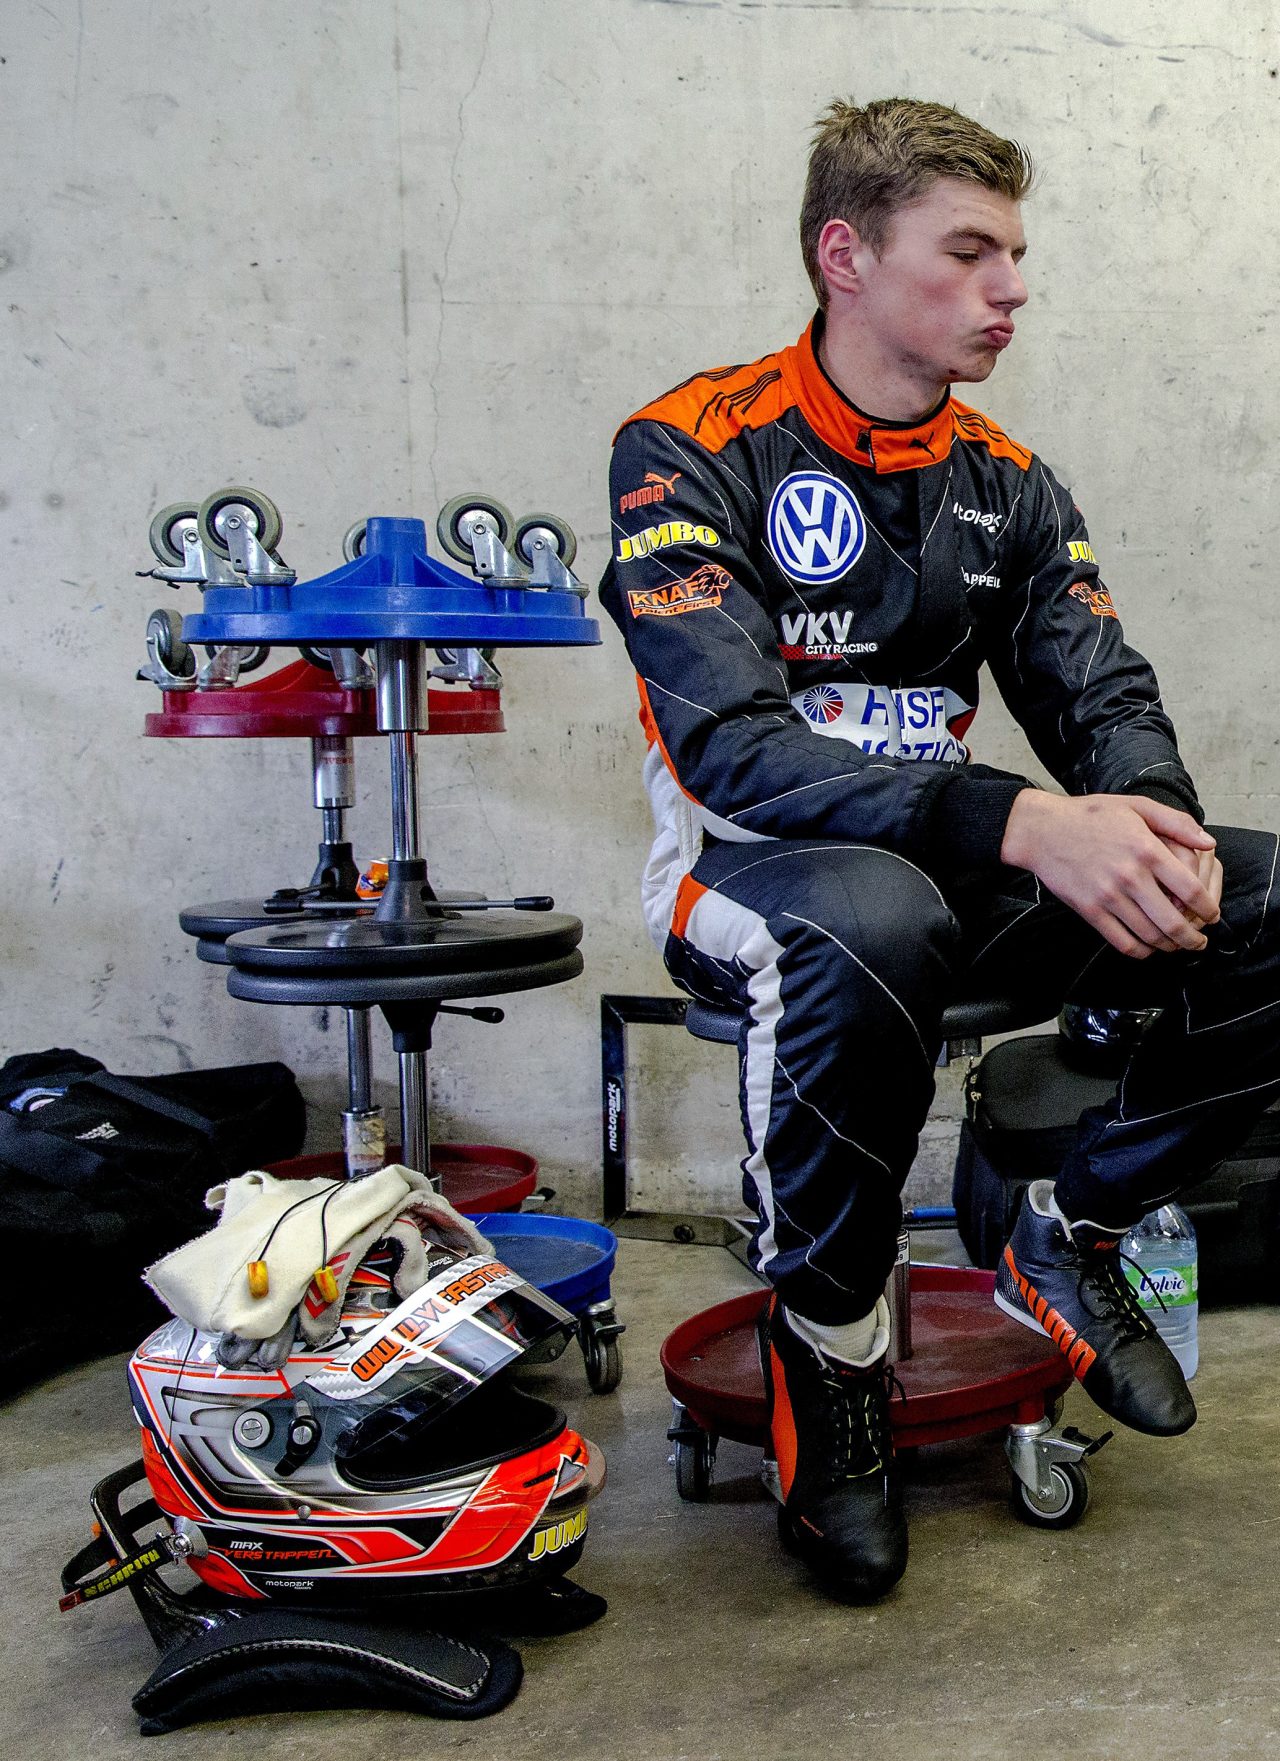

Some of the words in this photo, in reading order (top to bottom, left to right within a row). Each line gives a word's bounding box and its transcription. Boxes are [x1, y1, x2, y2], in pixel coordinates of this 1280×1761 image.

[620, 484, 665, 514] PUMA
[616, 521, 721, 562] JUMBO
[631, 580, 699, 606] KNAF
[781, 611, 854, 646] VKV
[805, 644, 833, 655] CITY
[833, 642, 879, 654] RACING
[607, 1081, 619, 1153] motopark
[1140, 1275, 1186, 1294] Volvic
[223, 1549, 338, 1560] VERSTAPPEN
[229, 1540, 264, 1551] MAX
[265, 1580, 314, 1588] motopark
